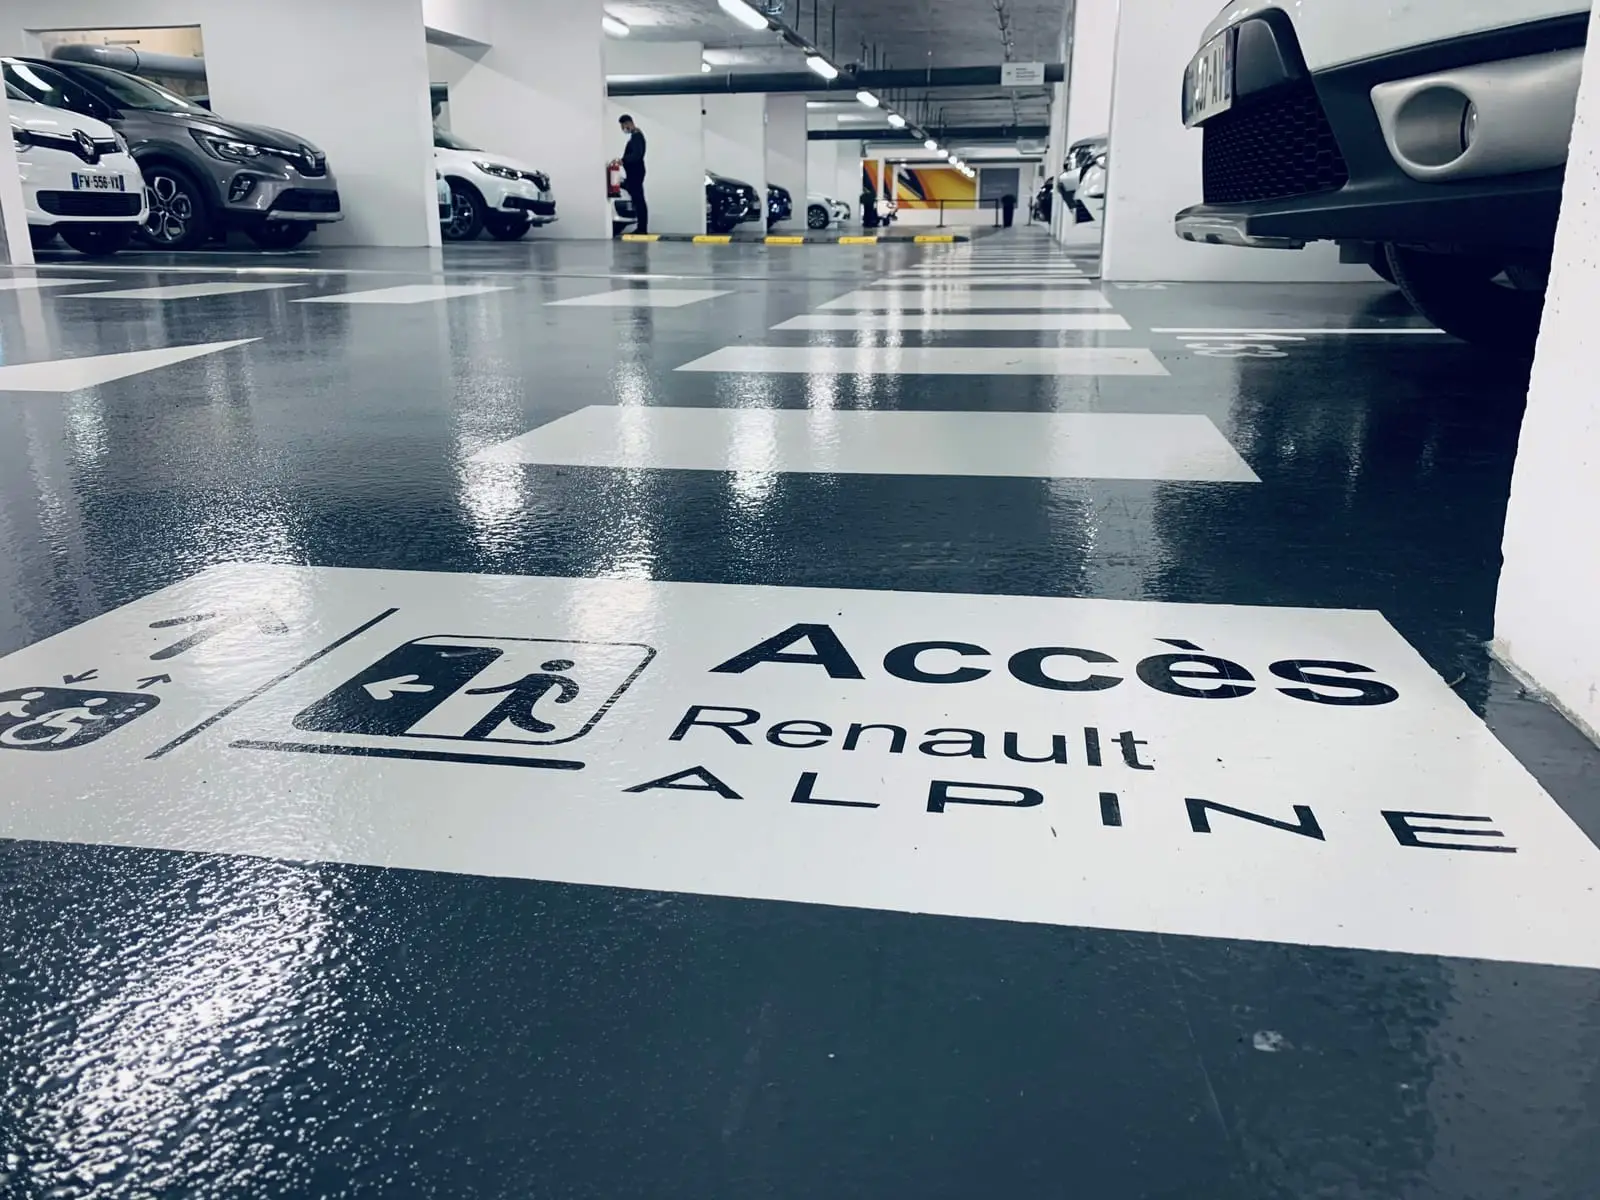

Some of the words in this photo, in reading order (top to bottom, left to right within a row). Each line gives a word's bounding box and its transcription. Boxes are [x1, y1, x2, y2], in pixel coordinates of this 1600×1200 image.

[707, 622, 1400, 706] Accès
[668, 704, 1155, 771] Renault
[621, 765, 1517, 854] ALPINE
